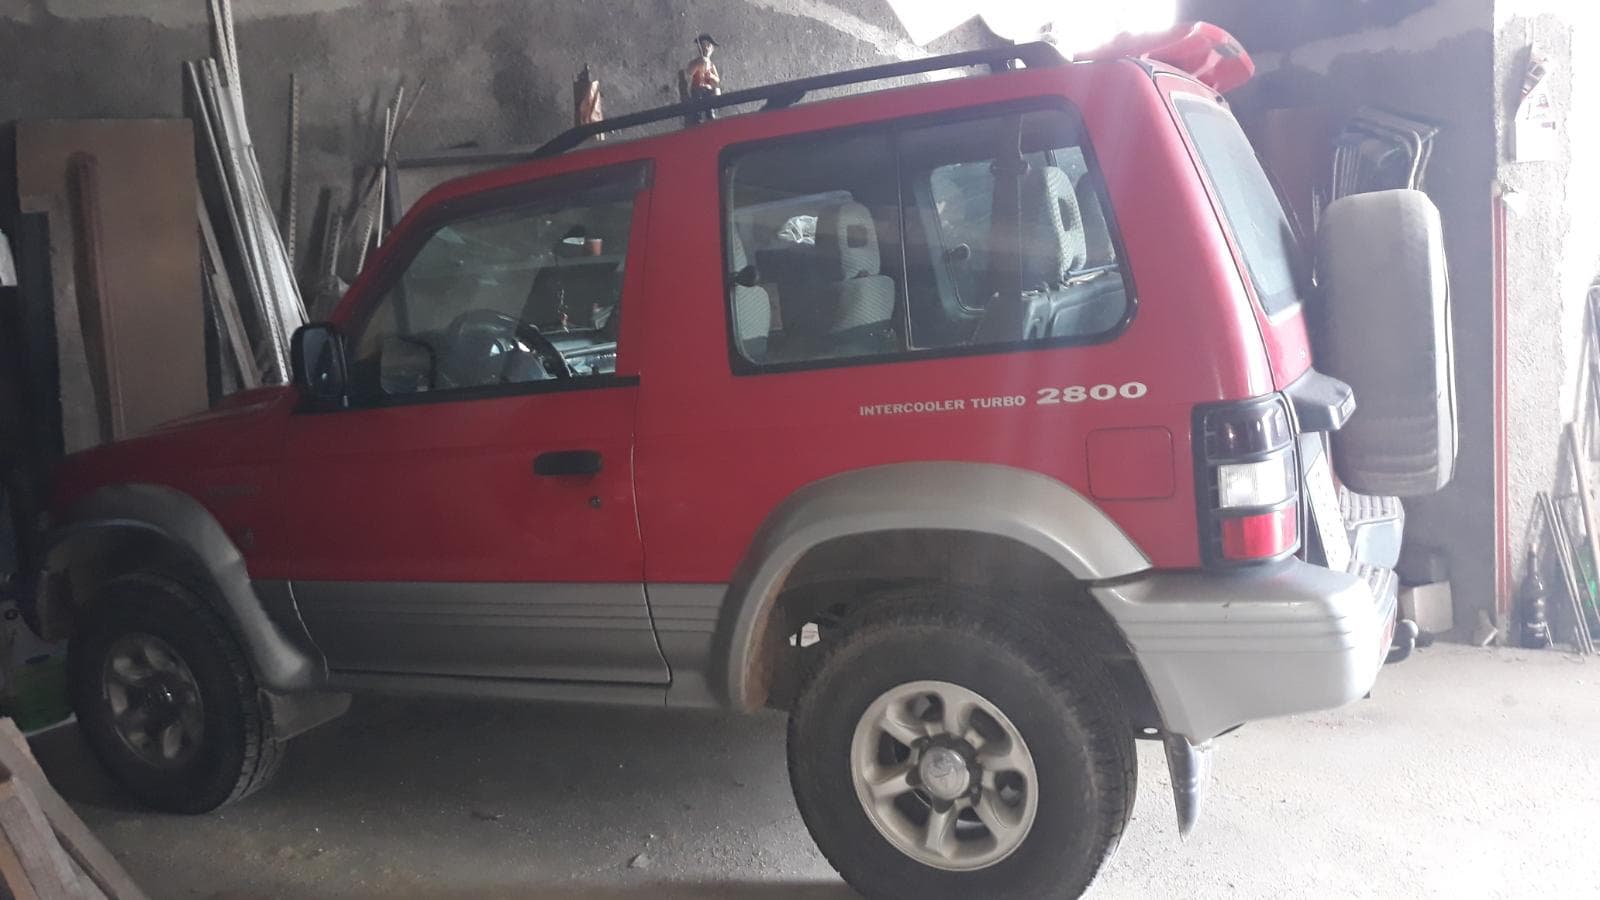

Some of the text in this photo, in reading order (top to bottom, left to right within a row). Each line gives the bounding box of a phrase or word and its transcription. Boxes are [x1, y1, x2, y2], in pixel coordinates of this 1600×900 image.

[859, 381, 1148, 416] INTERCOOLER TURBO 2800
